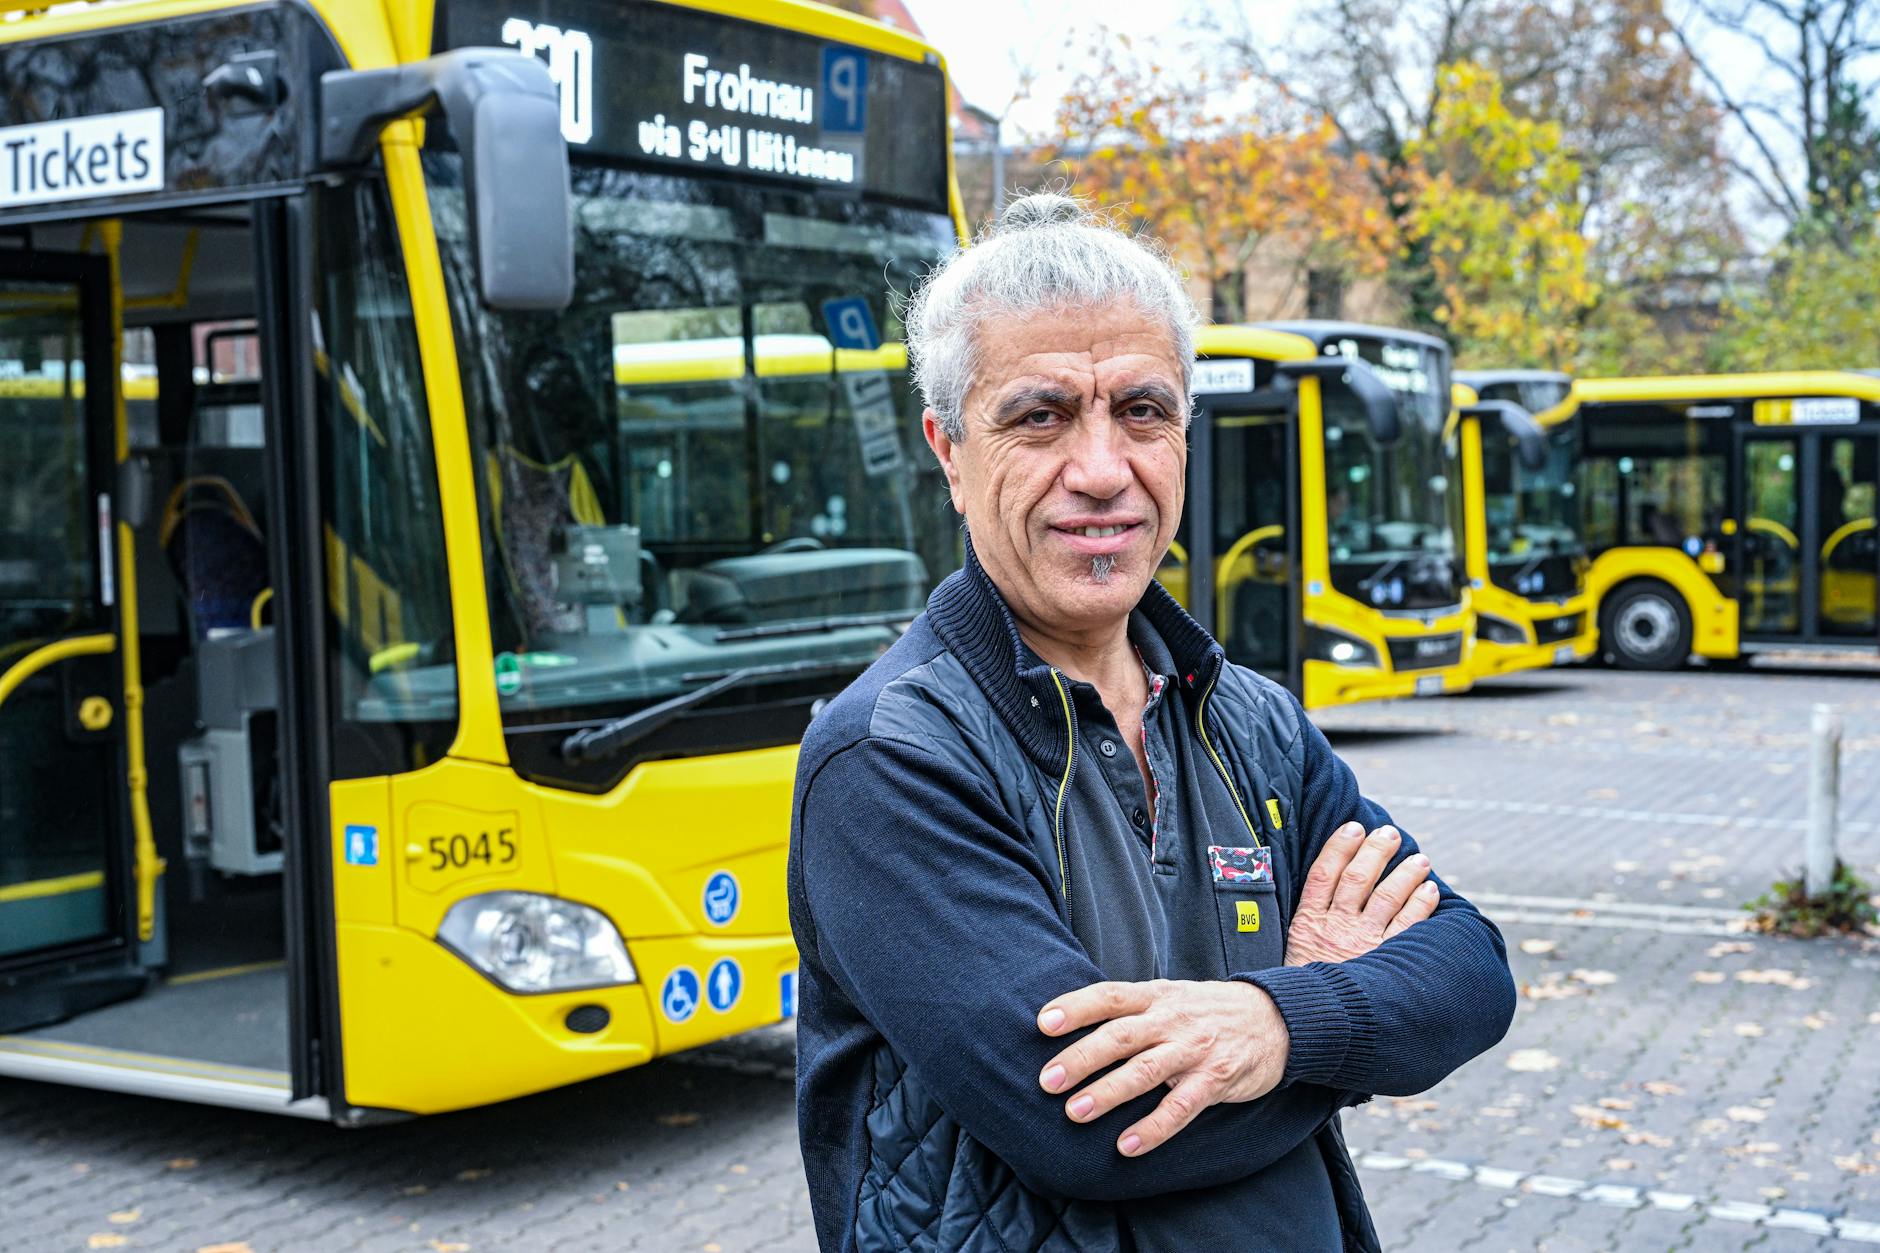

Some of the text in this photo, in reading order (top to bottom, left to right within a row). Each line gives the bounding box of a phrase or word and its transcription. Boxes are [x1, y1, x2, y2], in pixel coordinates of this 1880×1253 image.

[684, 53, 813, 124] Frohnau
[5, 130, 149, 193] Tickets
[638, 114, 682, 158] via
[688, 120, 742, 167] S+U
[428, 828, 517, 871] 5045
[1240, 913, 1257, 926] BVG
